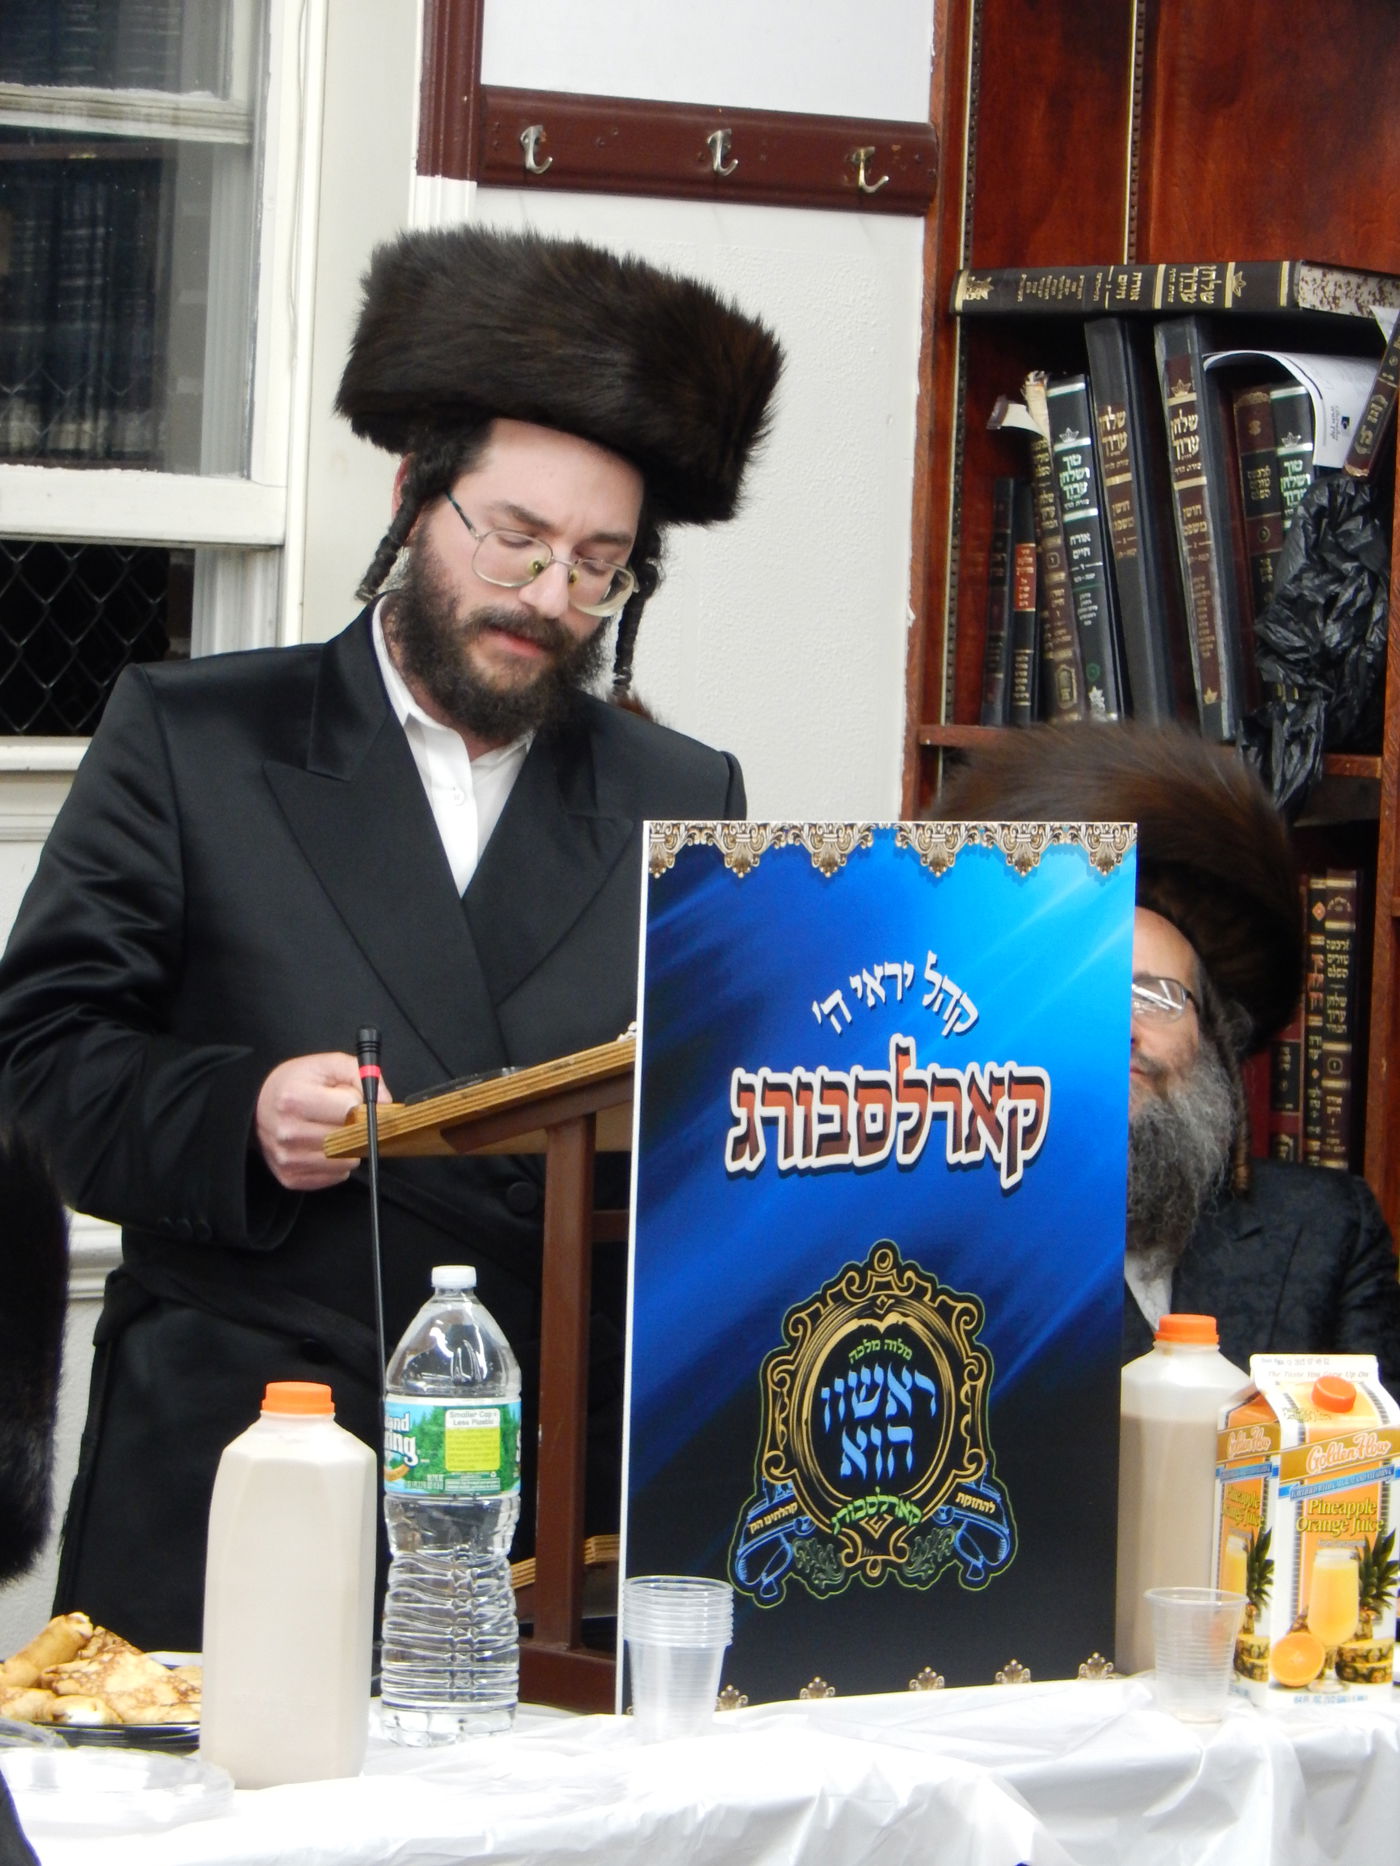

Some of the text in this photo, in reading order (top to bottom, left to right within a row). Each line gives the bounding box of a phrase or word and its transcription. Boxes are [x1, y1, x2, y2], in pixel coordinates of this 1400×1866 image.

[850, 961, 915, 1008] יראי
[922, 950, 980, 1036] קהל
[724, 1033, 1051, 1190] קארלסבורג
[848, 1338, 913, 1364] מלוה מלכה
[821, 1361, 937, 1433] ראשון
[840, 1422, 914, 1481] הוא
[1296, 1516, 1384, 1537] Orange Juice
[1308, 1497, 1377, 1520] Pineapple
